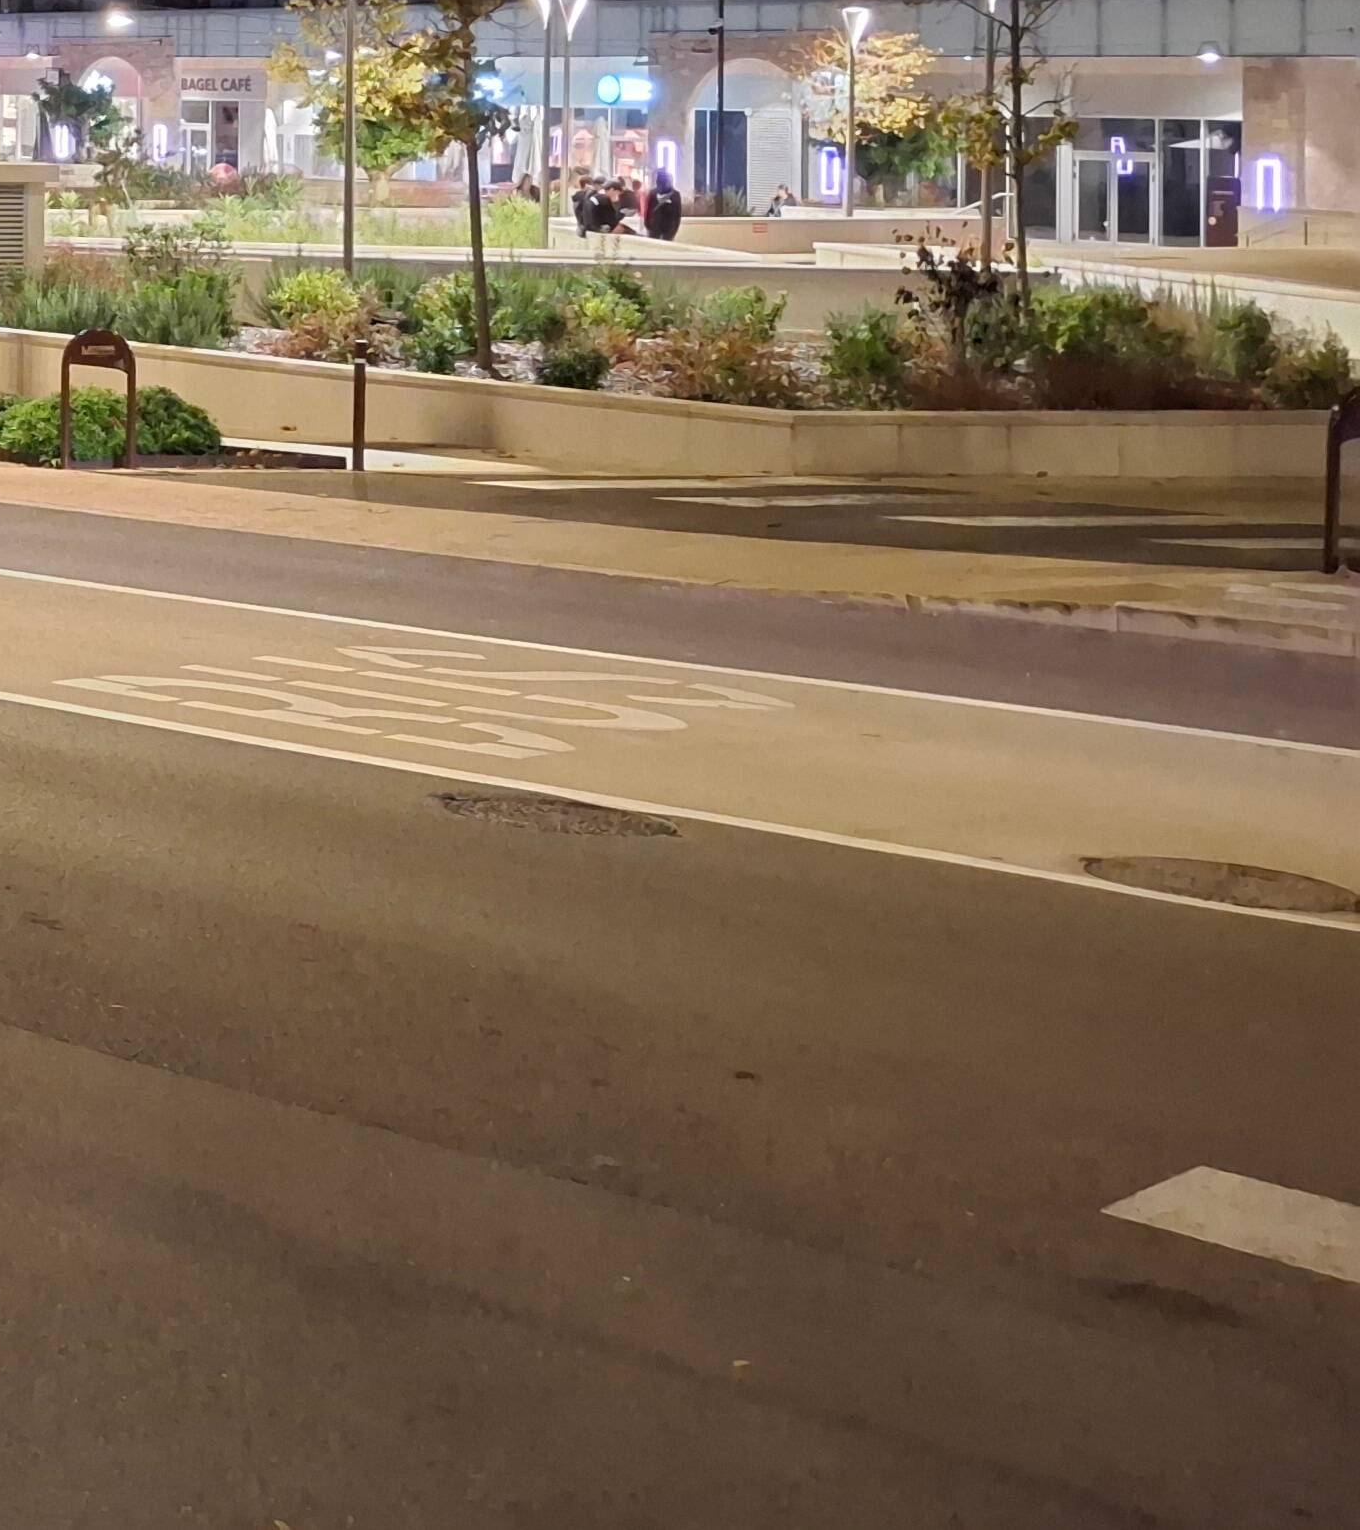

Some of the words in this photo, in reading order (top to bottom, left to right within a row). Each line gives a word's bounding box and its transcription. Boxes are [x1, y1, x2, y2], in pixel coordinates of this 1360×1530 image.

[181, 77, 218, 91] BAGEL
[221, 75, 252, 91] CAFÉ
[53, 644, 796, 759] BUS
